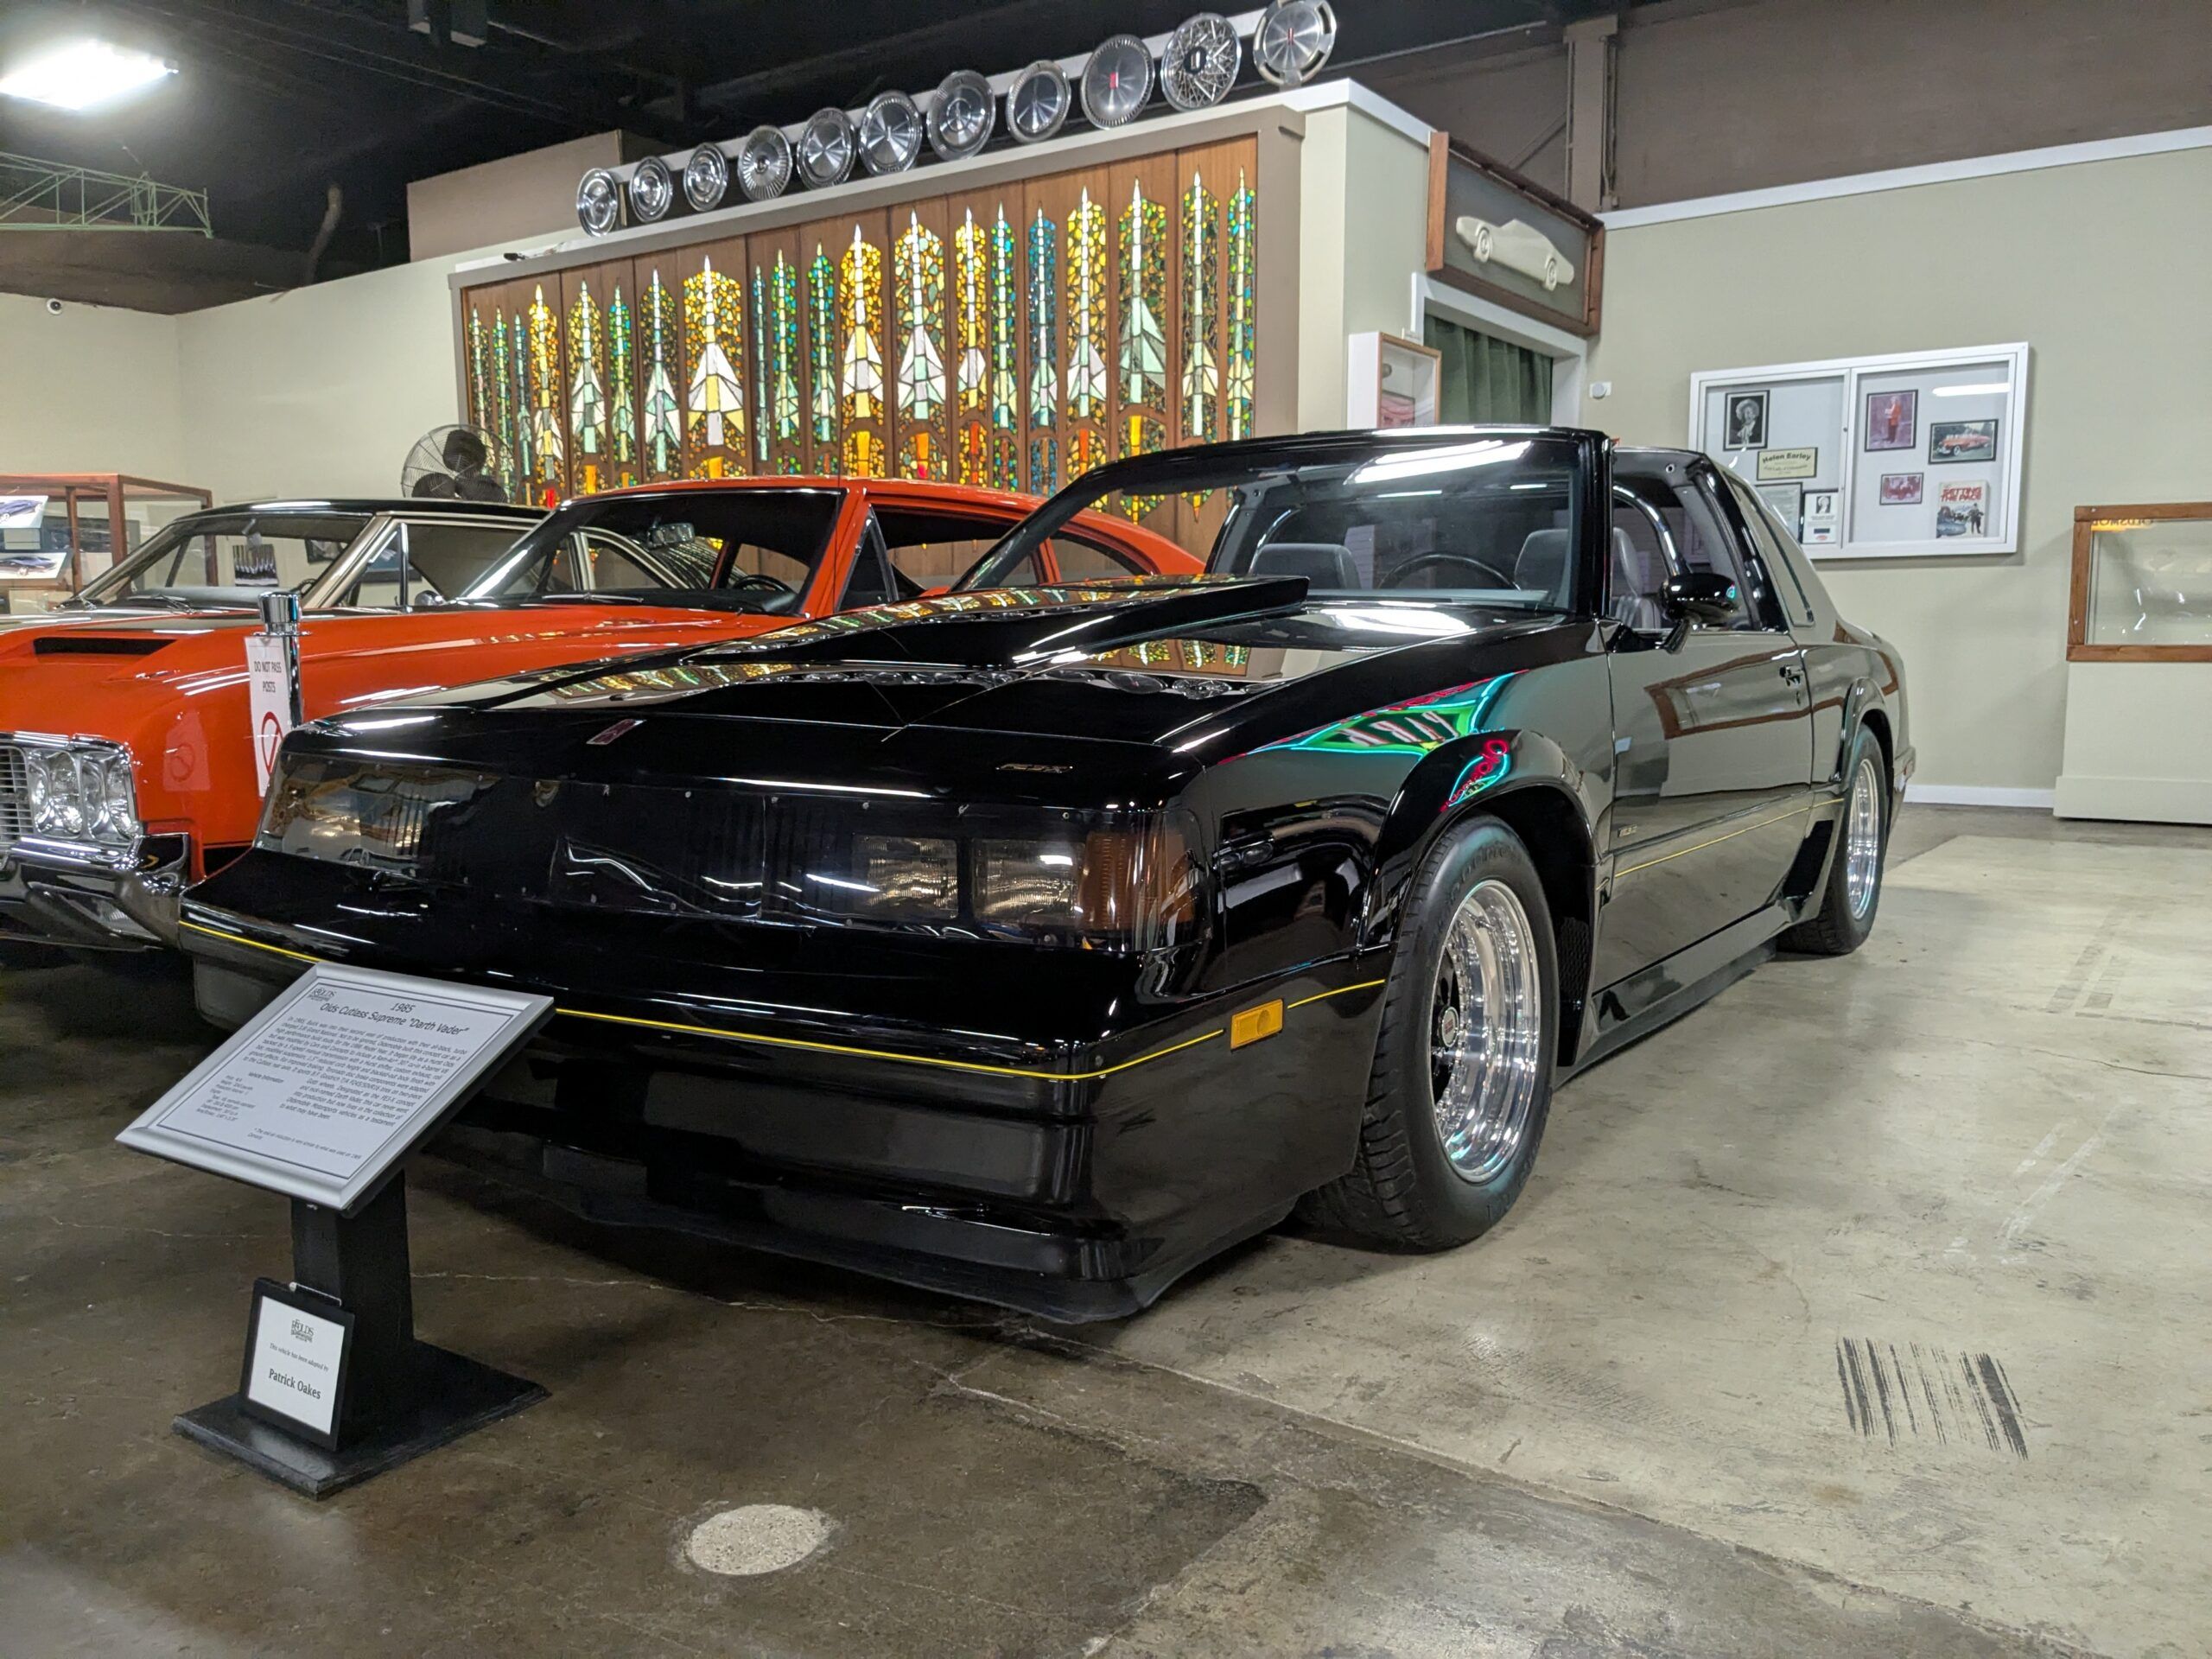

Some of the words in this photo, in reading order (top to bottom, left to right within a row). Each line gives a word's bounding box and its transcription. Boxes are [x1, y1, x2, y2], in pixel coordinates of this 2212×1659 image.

[254, 661, 262, 672] DO
[262, 661, 270, 672] NOT
[271, 661, 282, 673] PASS
[262, 681, 276, 693] POSTS
[391, 1002, 416, 1014] 1985
[320, 1003, 339, 1013] Olds
[339, 1005, 369, 1019] Cutlass
[367, 1011, 407, 1026] Supreme
[409, 1018, 436, 1031] "Darth
[436, 1023, 470, 1035] Vader"
[269, 1368, 296, 1389] Patrick
[297, 1380, 321, 1399] Oakes
